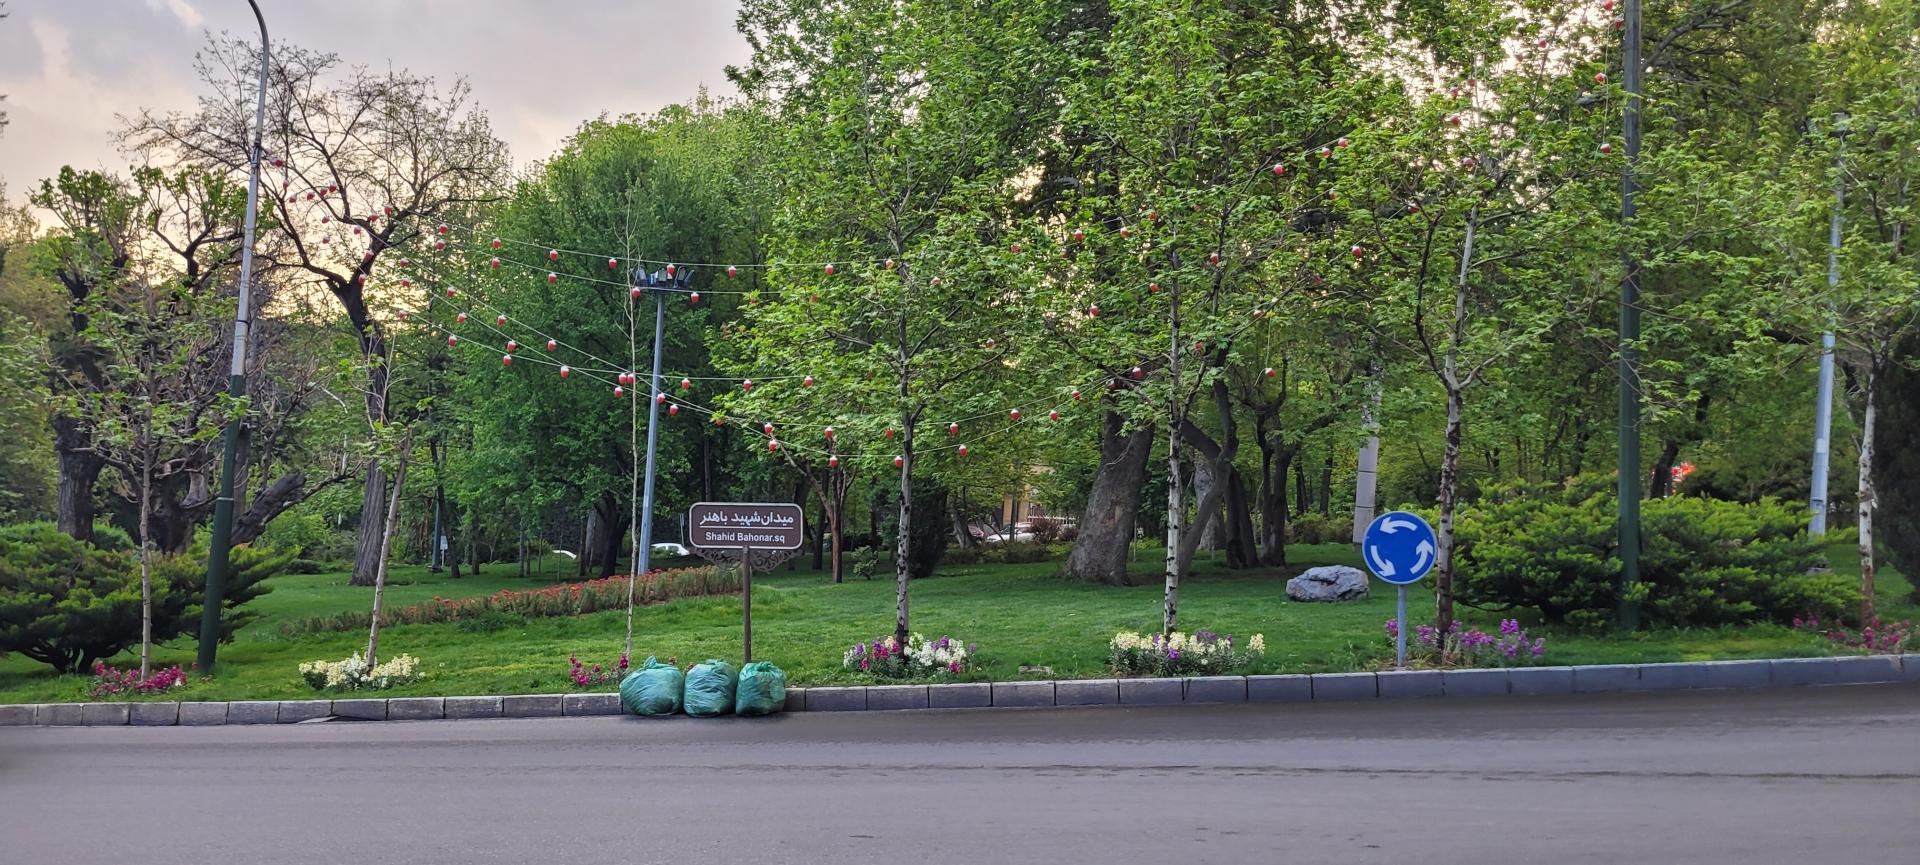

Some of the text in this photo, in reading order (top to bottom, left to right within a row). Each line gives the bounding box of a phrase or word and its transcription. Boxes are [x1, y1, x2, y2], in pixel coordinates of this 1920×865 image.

[699, 511, 728, 525] باهنر
[705, 531, 785, 544] Shahid Bahonar.sq
